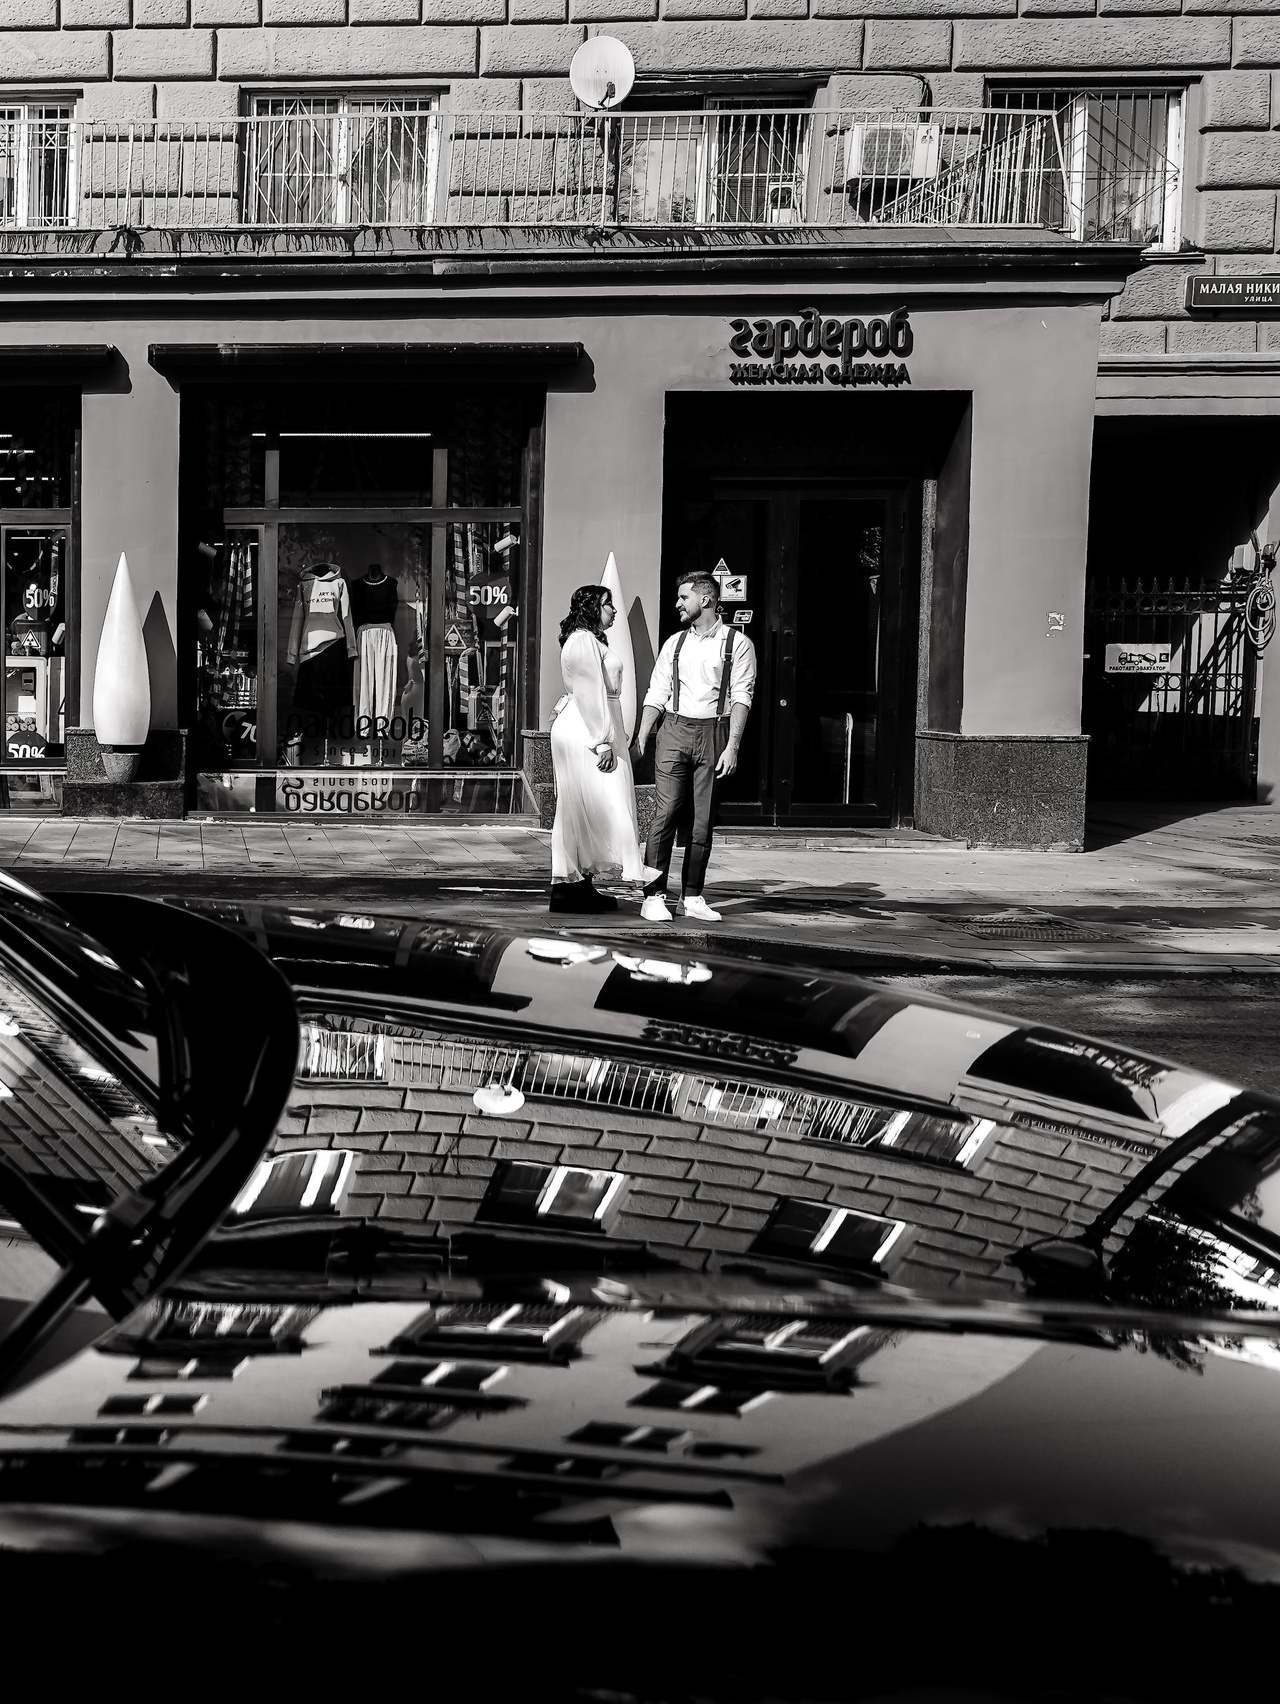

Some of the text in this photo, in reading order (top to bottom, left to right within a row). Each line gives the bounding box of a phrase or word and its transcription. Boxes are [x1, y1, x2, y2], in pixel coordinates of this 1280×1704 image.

[1200, 283, 1242, 294] МАЛАЯ
[729, 306, 911, 365] гардероб
[729, 363, 909, 382] ЖЕНСКАЯ ОДЕЖДА
[26, 588, 55, 608] 50%
[469, 585, 508, 605] 50%
[8, 743, 45, 758] 50%
